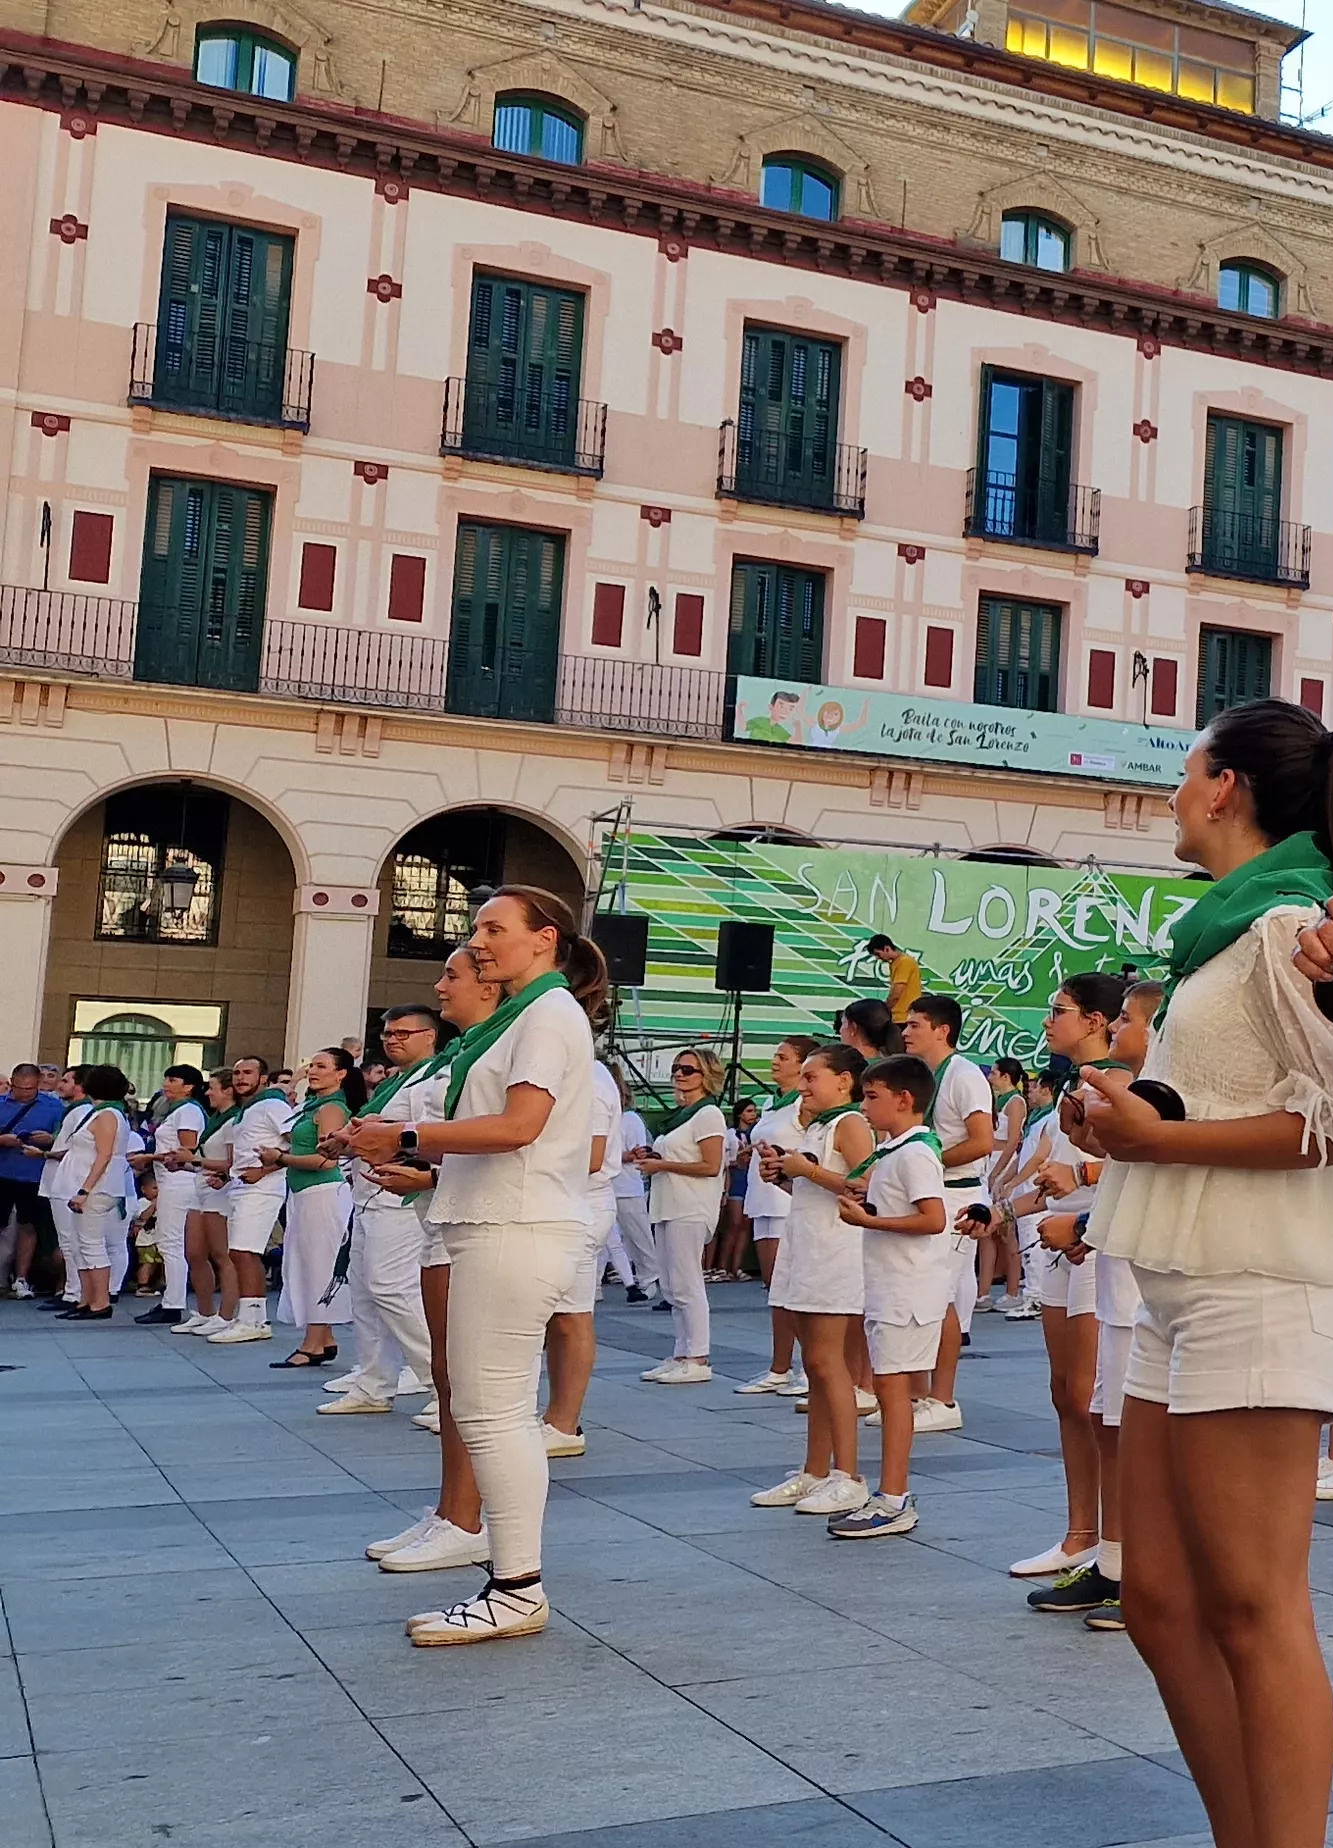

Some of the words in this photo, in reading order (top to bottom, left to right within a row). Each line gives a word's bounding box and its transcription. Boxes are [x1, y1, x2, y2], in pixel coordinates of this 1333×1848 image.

[902, 708, 941, 728] Baila
[944, 719, 966, 729] con
[968, 721, 1017, 737] nosotros
[881, 723, 894, 738] la
[893, 725, 922, 743] jota
[946, 729, 972, 746] San
[976, 731, 1029, 752] Lorenzo
[1145, 737, 1190, 752] AltoAr
[1127, 762, 1161, 773] AMBAR
[796, 862, 903, 924] SAN
[928, 869, 1200, 951] LORENZ
[951, 958, 1034, 996] unas
